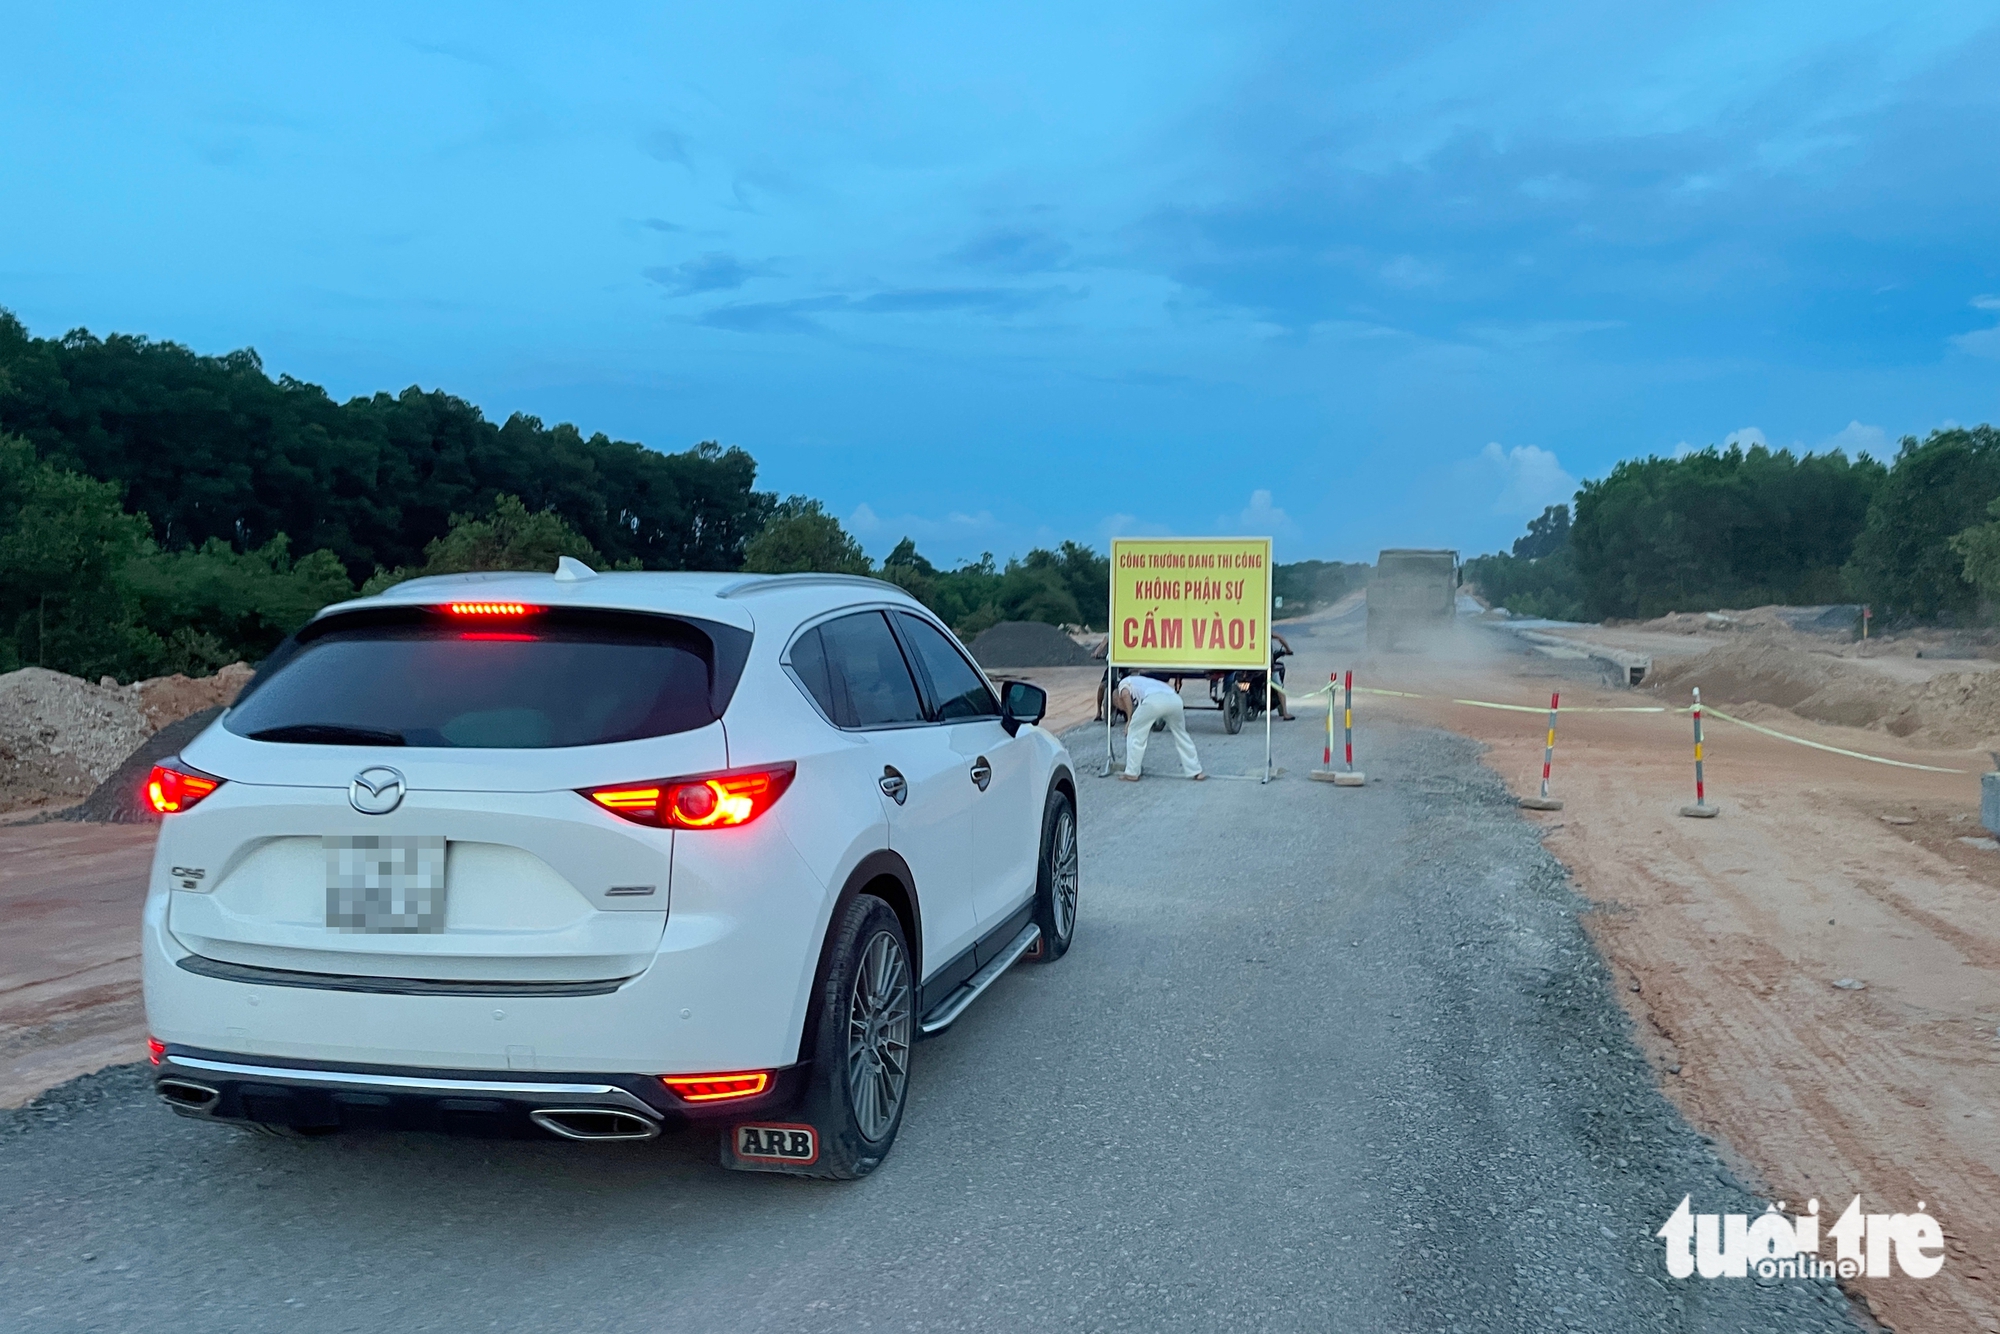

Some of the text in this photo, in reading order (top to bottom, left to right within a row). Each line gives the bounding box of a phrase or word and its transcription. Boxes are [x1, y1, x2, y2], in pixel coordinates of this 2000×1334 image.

[1120, 550, 1145, 569] CÔNG
[1217, 553, 1232, 569] THI
[1135, 576, 1245, 605] KHÔNG PHẬN SỰ
[1123, 606, 1256, 650] CẤM VÀO!
[742, 1129, 811, 1157] ARB
